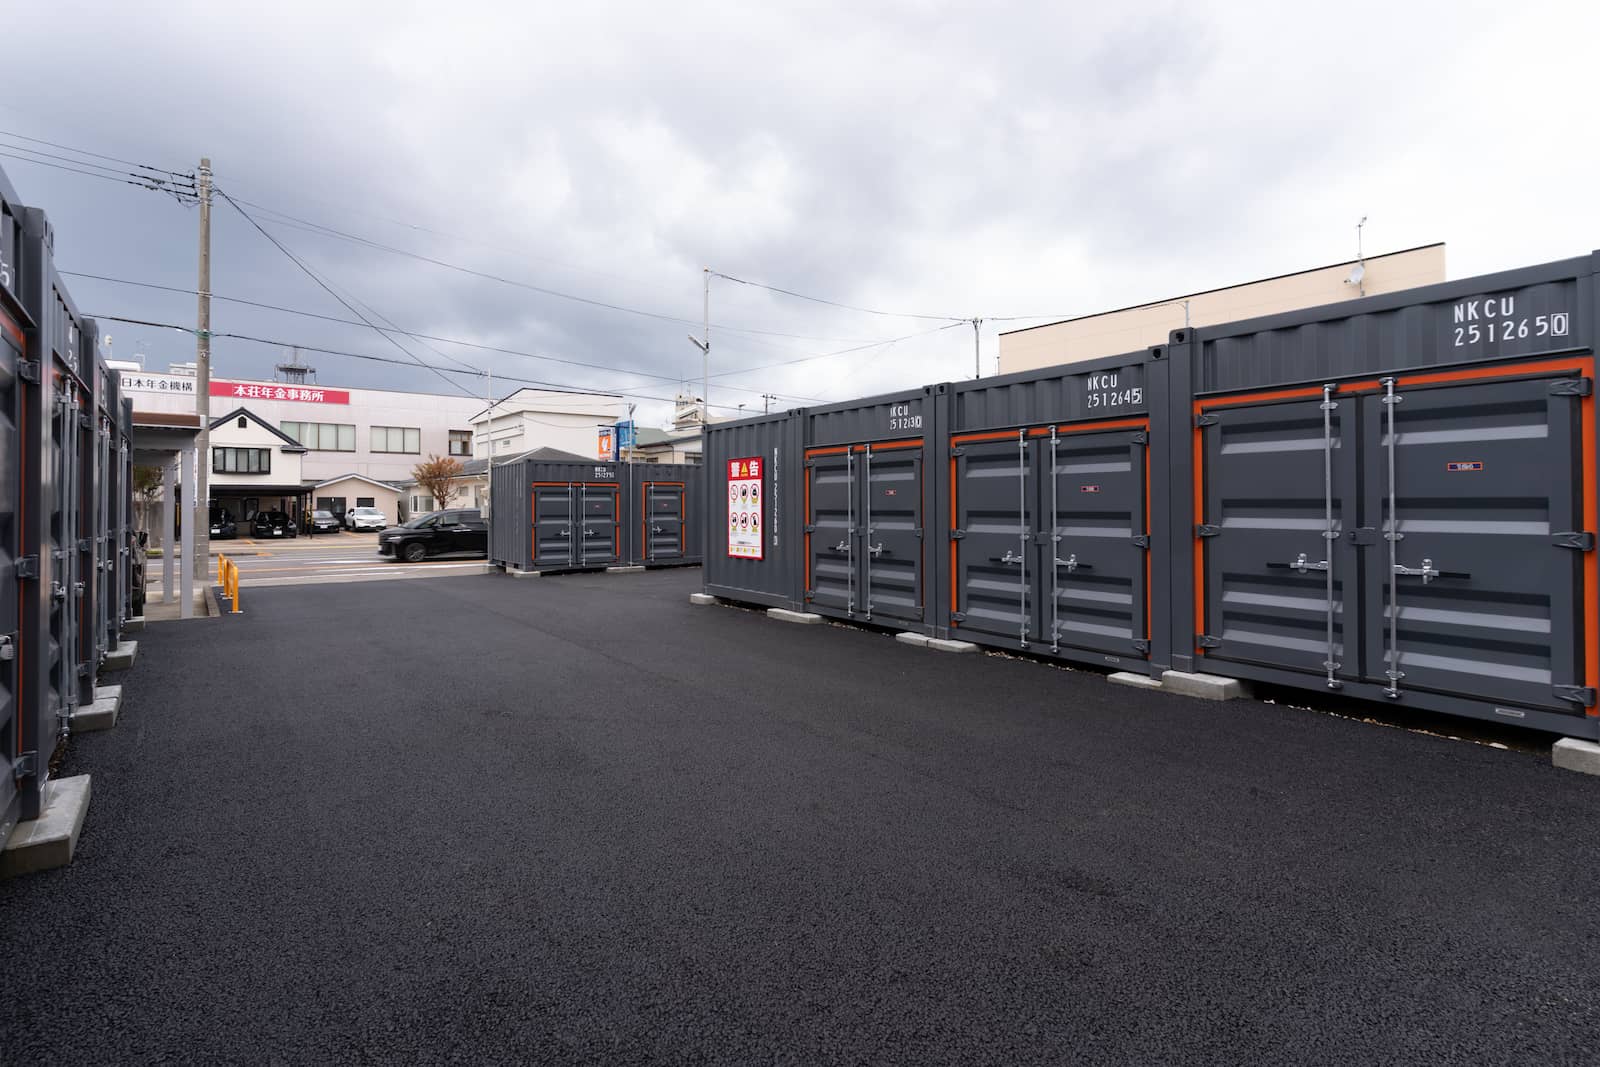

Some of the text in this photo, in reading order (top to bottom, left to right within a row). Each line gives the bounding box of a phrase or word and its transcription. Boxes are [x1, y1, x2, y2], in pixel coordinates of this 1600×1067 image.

[1454, 296, 1515, 324] NKCU
[121, 377, 193, 392] 日本年金機構
[1087, 373, 1118, 391] NKCU
[233, 384, 325, 402] 本荘年金事務所
